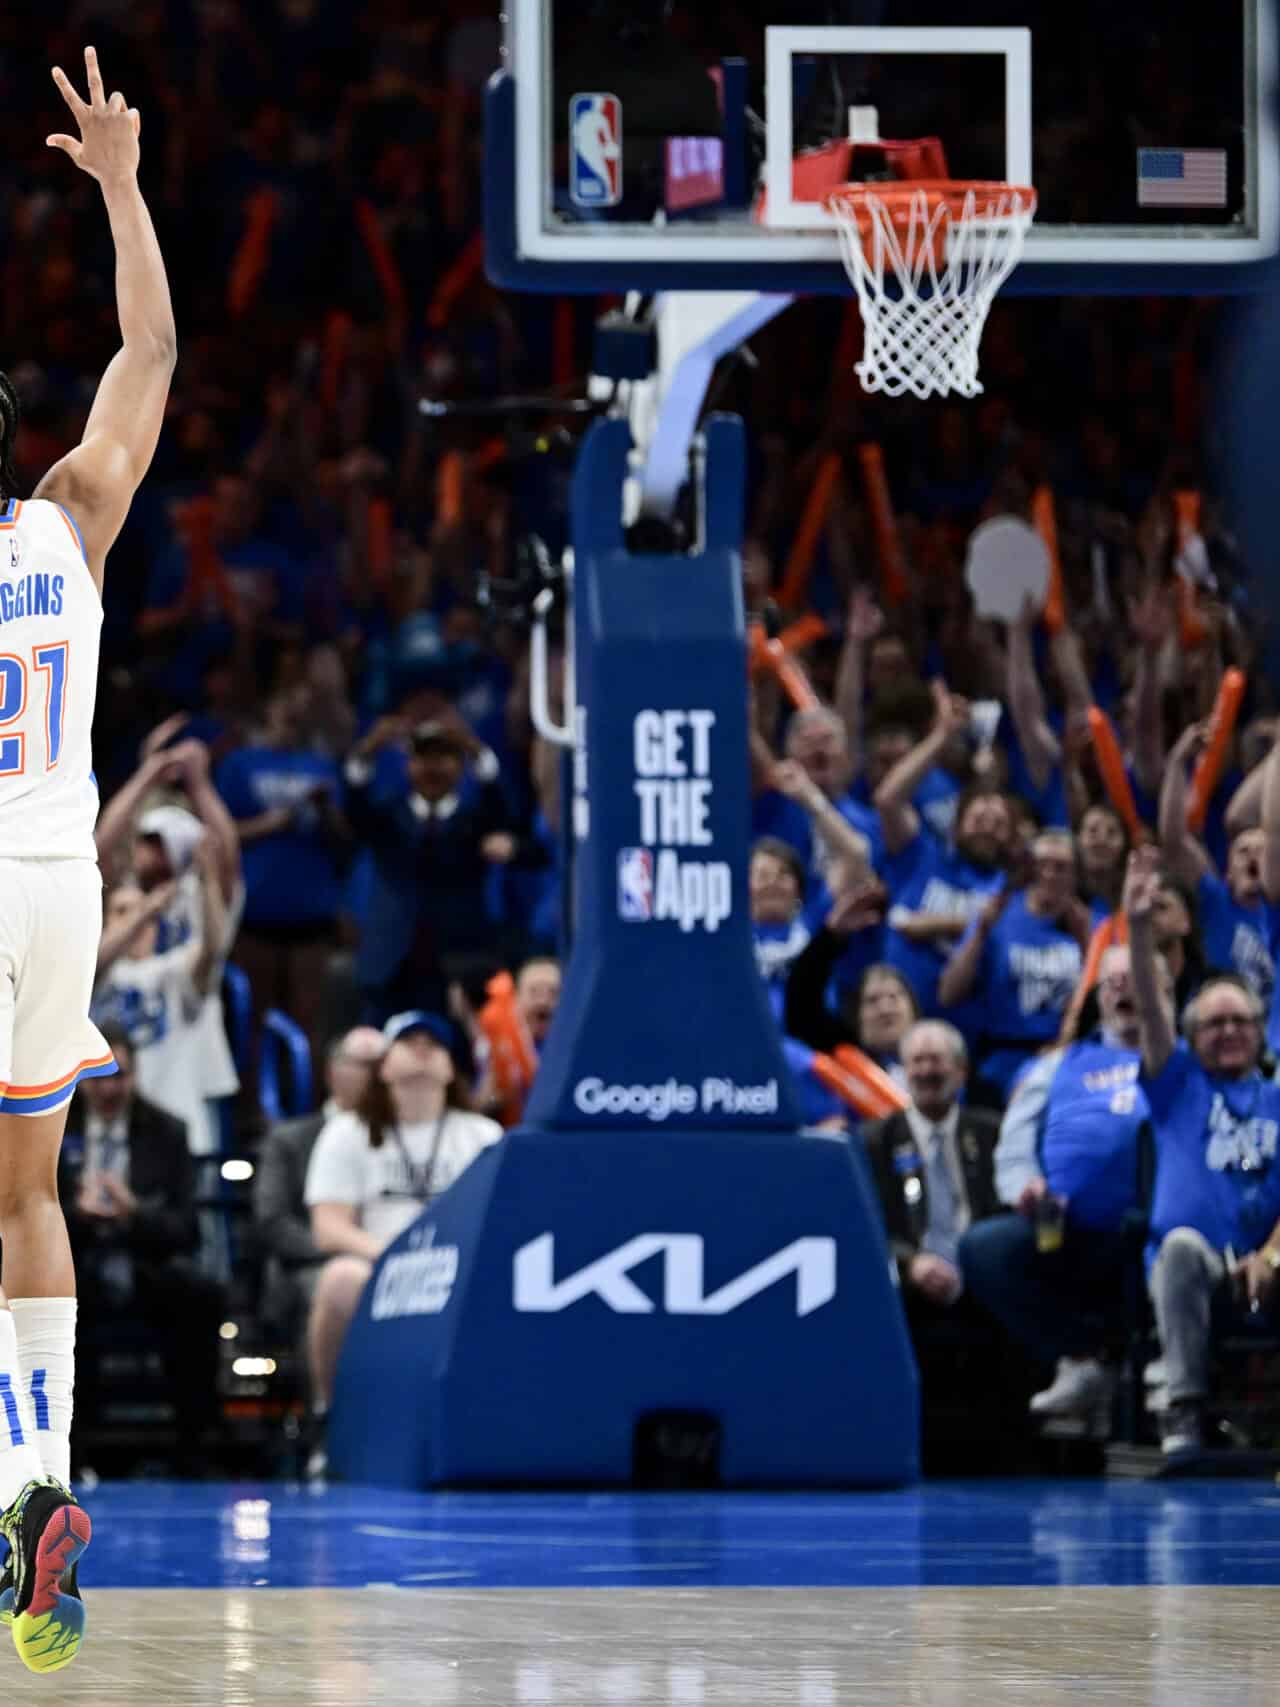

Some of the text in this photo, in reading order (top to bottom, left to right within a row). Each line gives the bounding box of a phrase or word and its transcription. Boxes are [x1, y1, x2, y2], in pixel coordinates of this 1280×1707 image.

[634, 709, 716, 777] GET
[634, 779, 714, 846] THE
[656, 848, 732, 933] App
[574, 1077, 779, 1121] Google Pixel
[514, 1232, 837, 1318] KIA
